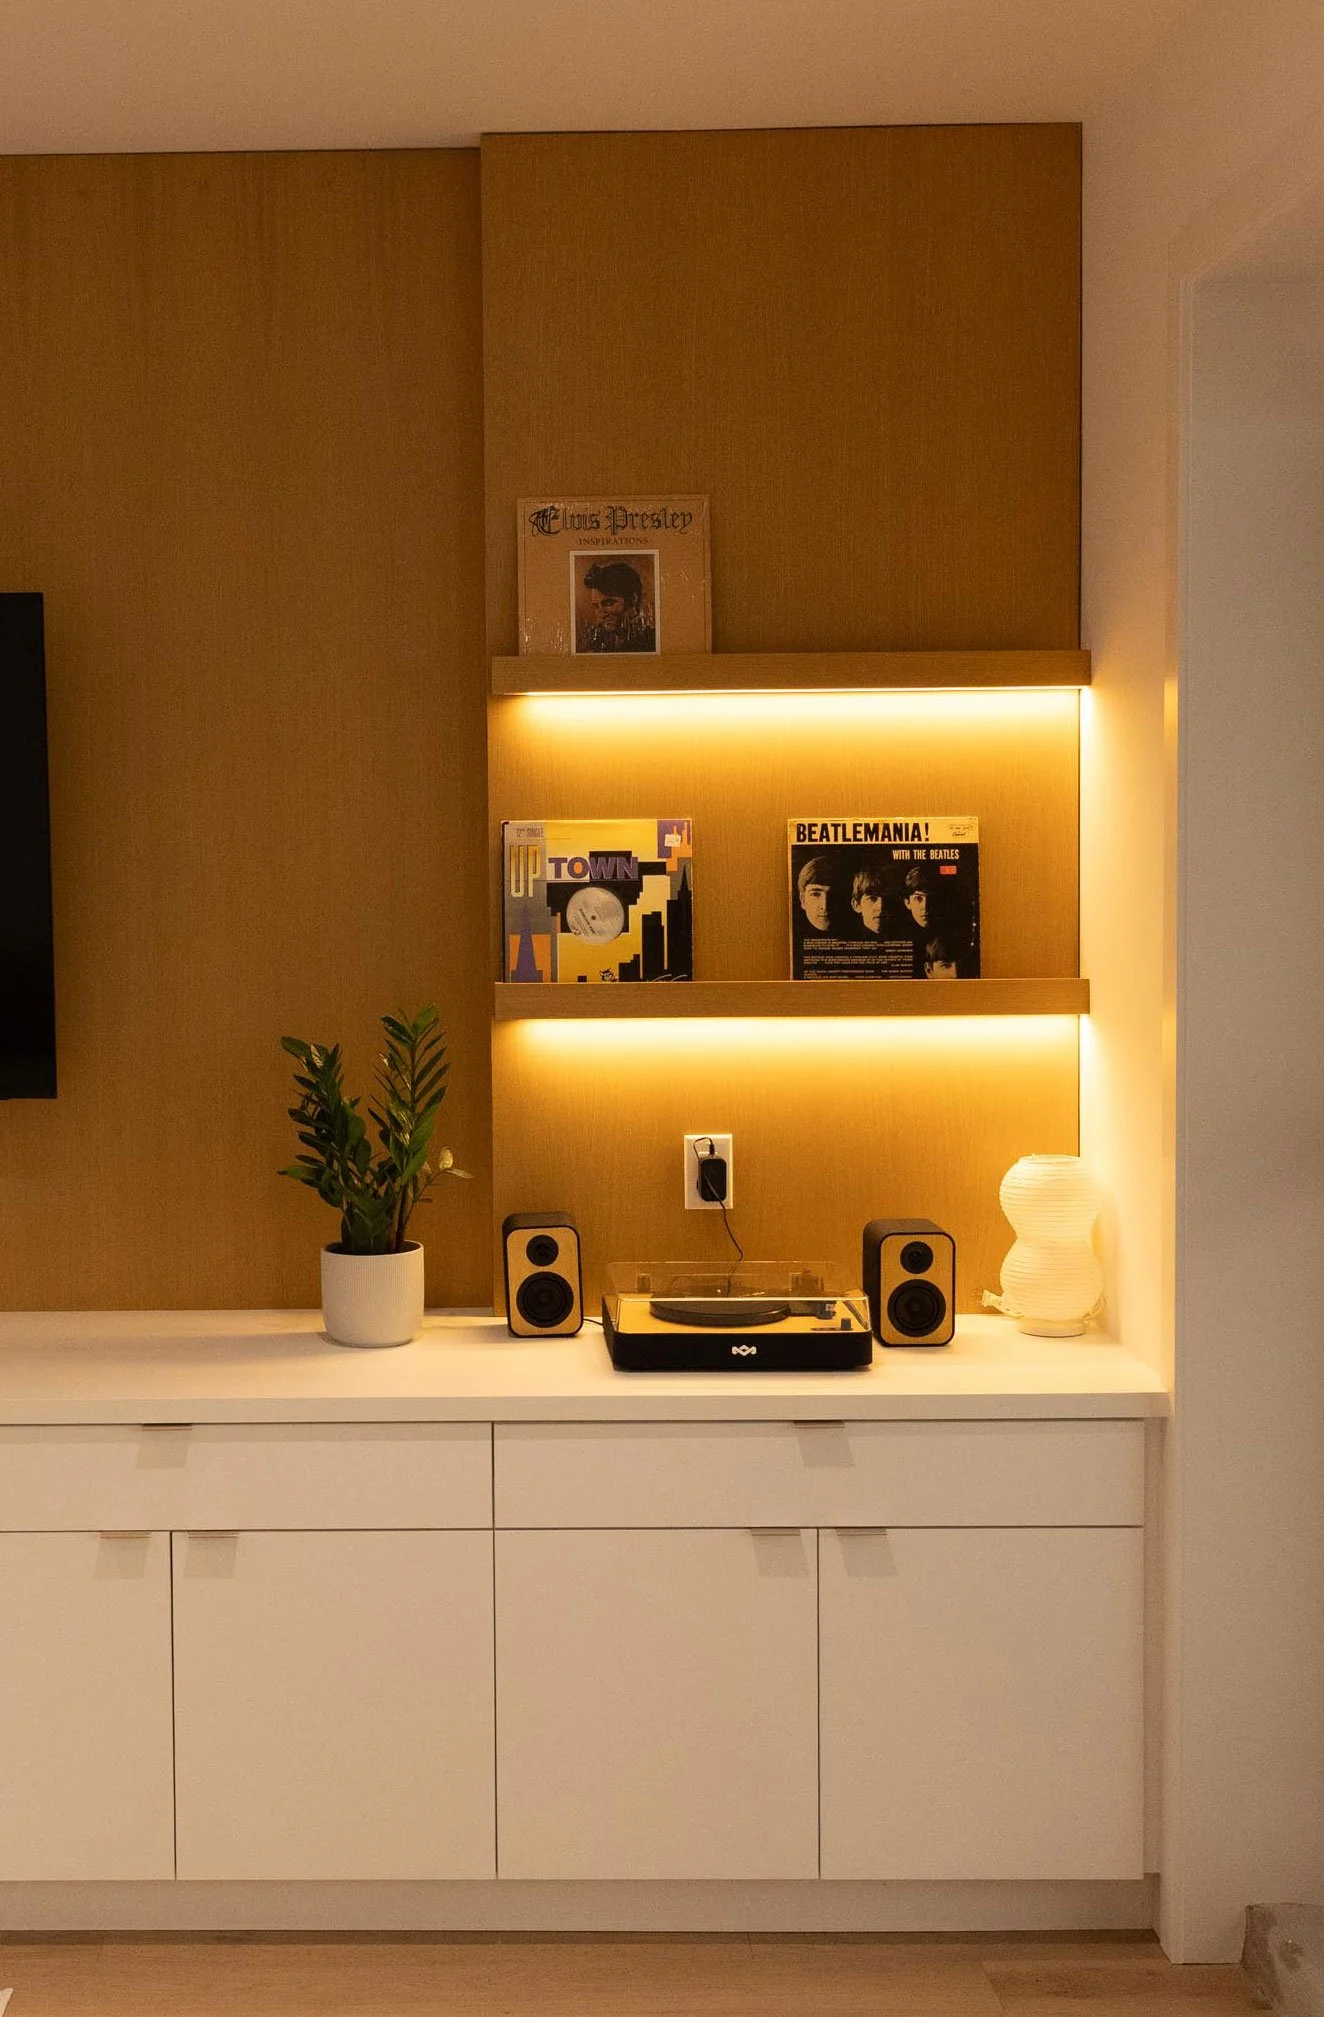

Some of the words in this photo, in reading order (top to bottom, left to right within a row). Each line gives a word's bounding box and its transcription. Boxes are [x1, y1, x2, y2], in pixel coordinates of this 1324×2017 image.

[605, 505, 693, 535] Presley
[578, 537, 649, 546] INSPIRATIONS
[796, 823, 930, 843] BEATLEMANIA!
[892, 850, 910, 860] WITH
[913, 850, 926, 860] THE
[930, 849, 960, 860] BEATLES
[509, 844, 541, 898] UP
[548, 857, 638, 880] TOWN
